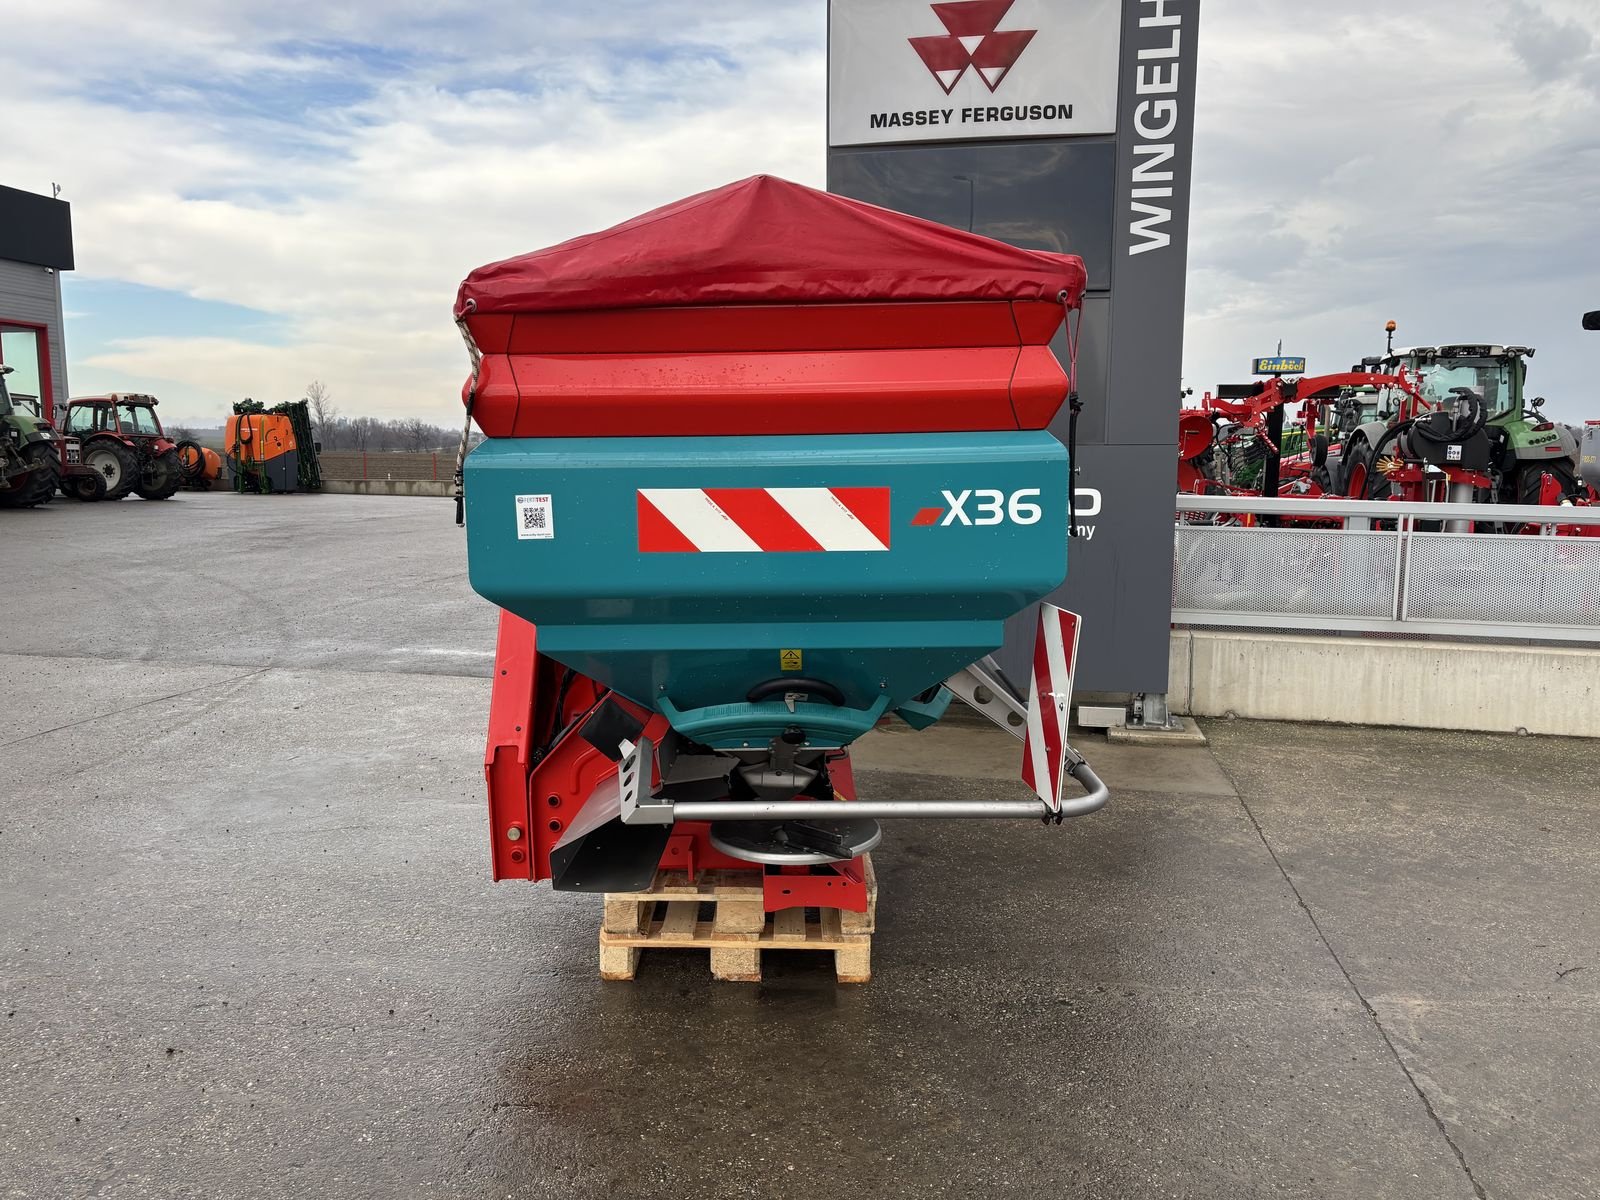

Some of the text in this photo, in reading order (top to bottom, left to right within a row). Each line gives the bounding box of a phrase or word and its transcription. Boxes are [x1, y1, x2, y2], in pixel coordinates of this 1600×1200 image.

[870, 104, 1073, 128] MASSEY FERGUSON
[940, 488, 1042, 526] X36
